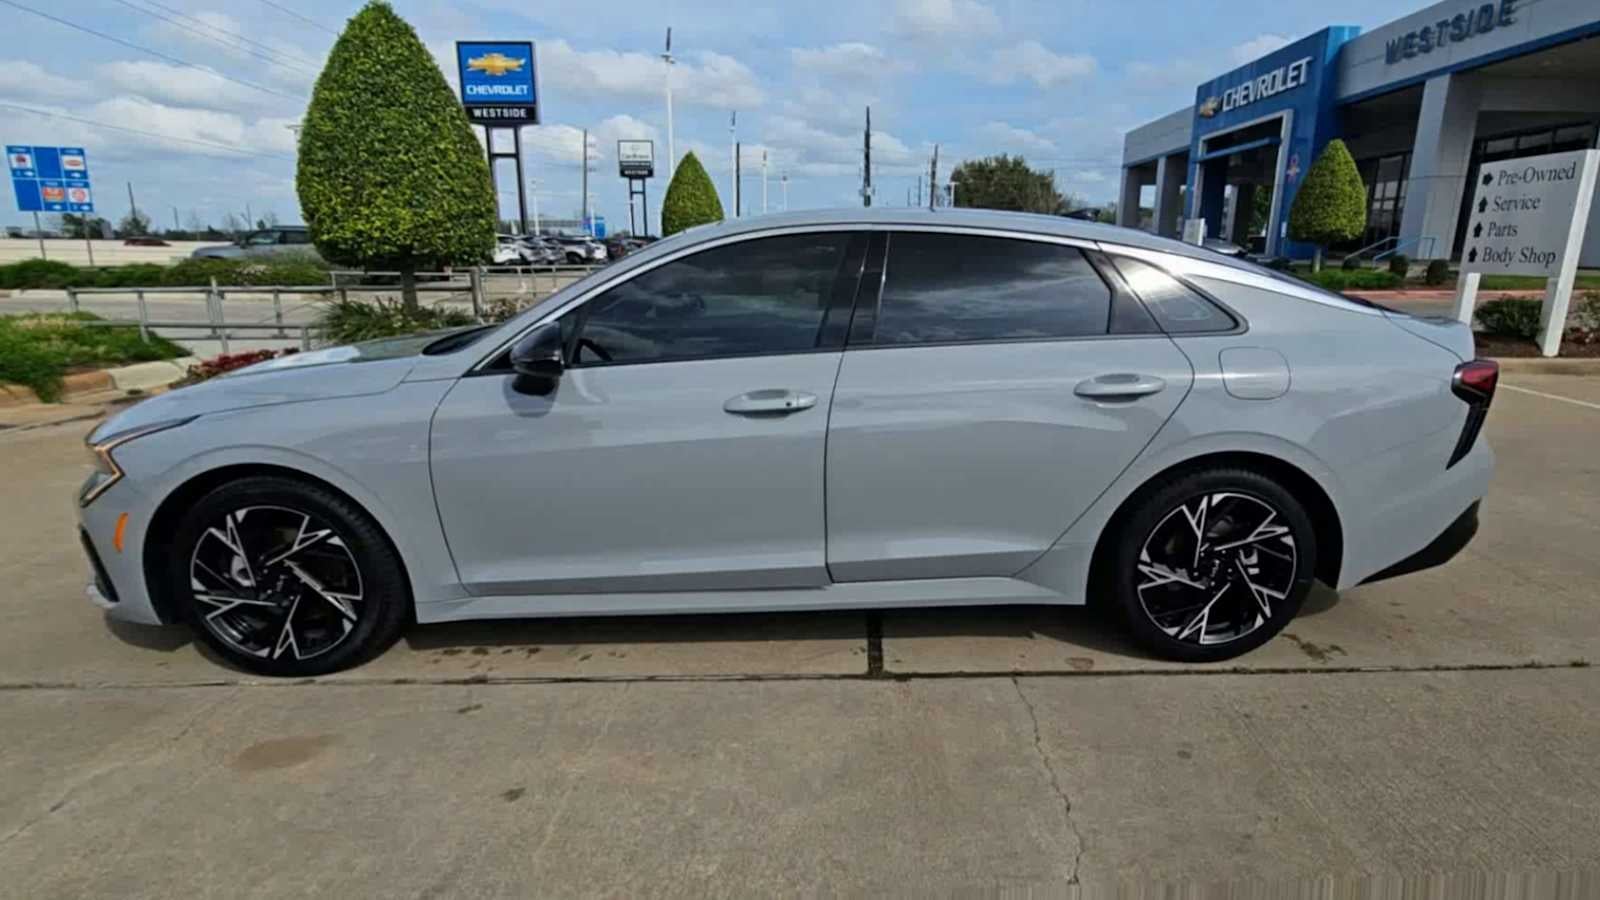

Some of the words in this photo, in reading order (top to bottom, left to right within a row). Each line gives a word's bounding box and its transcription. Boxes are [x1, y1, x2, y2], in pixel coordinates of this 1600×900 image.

[1385, 0, 1518, 65] WESTSIDE
[465, 84, 528, 96] CHEVROLET
[1222, 56, 1312, 112] CHEVROLET
[472, 107, 527, 118] WESTSIDE
[1498, 161, 1577, 186] Pre-Owned
[1492, 194, 1541, 212] Service
[1487, 221, 1518, 238] Parts
[1482, 246, 1516, 267] Body
[1519, 246, 1557, 268] Shop
